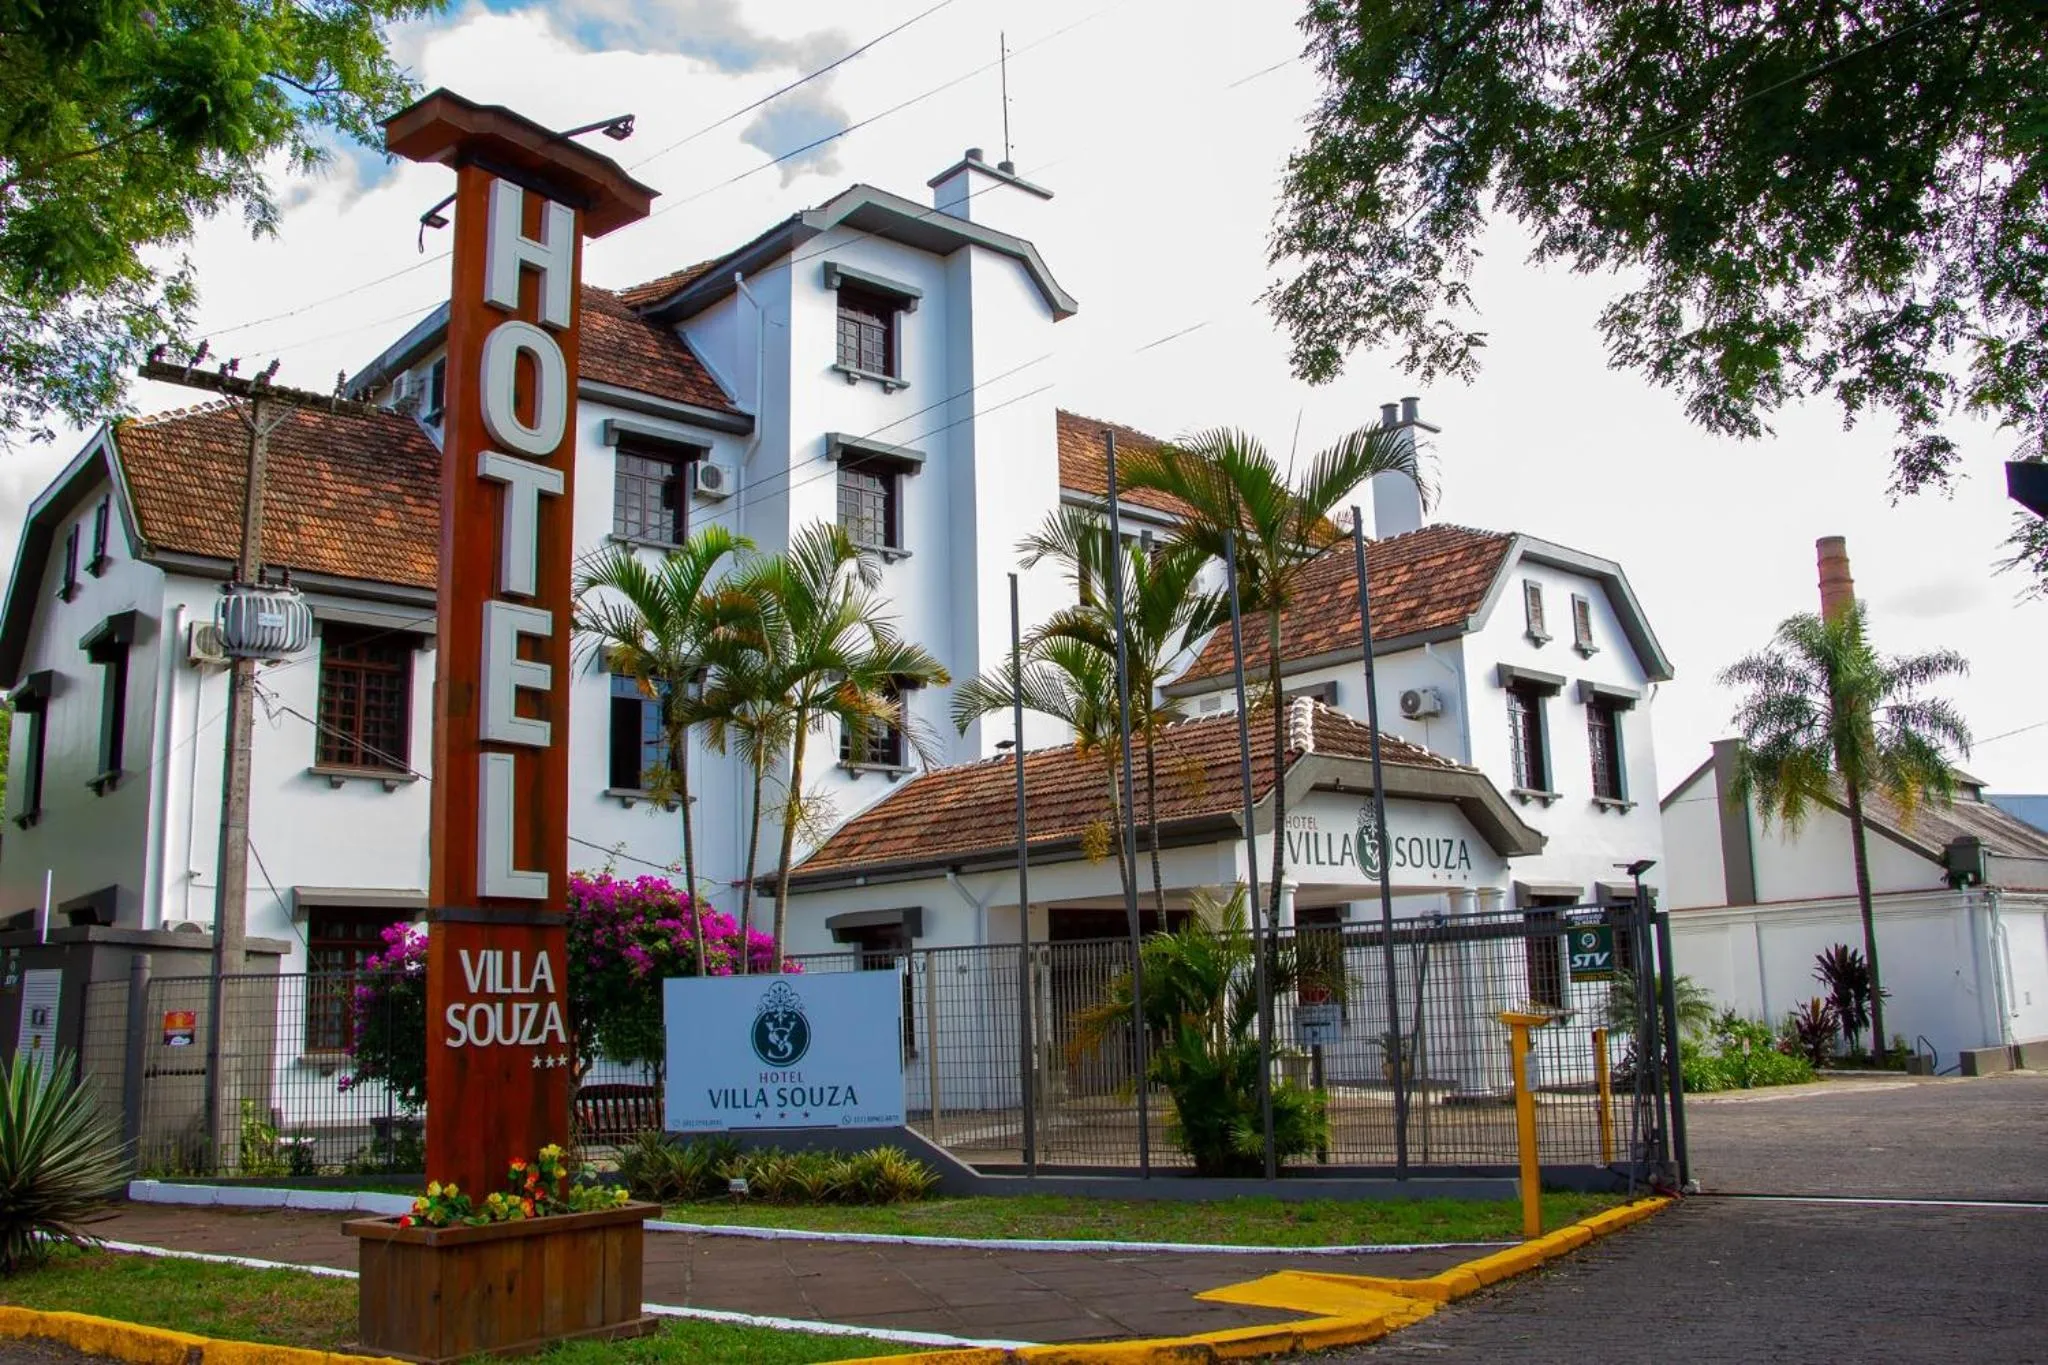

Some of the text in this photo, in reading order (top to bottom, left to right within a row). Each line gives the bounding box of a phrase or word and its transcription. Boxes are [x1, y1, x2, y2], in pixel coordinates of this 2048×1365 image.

[477, 177, 576, 900] HOTEL
[1285, 815, 1318, 830] HOTEL
[1286, 831, 1472, 870] VILLA SOUZA
[459, 949, 556, 994] VILLA
[1571, 951, 1610, 968] STV
[445, 1001, 567, 1048] SOUZA
[759, 1071, 804, 1084] HOTEL
[708, 1085, 859, 1110] VILLA SOUZA
